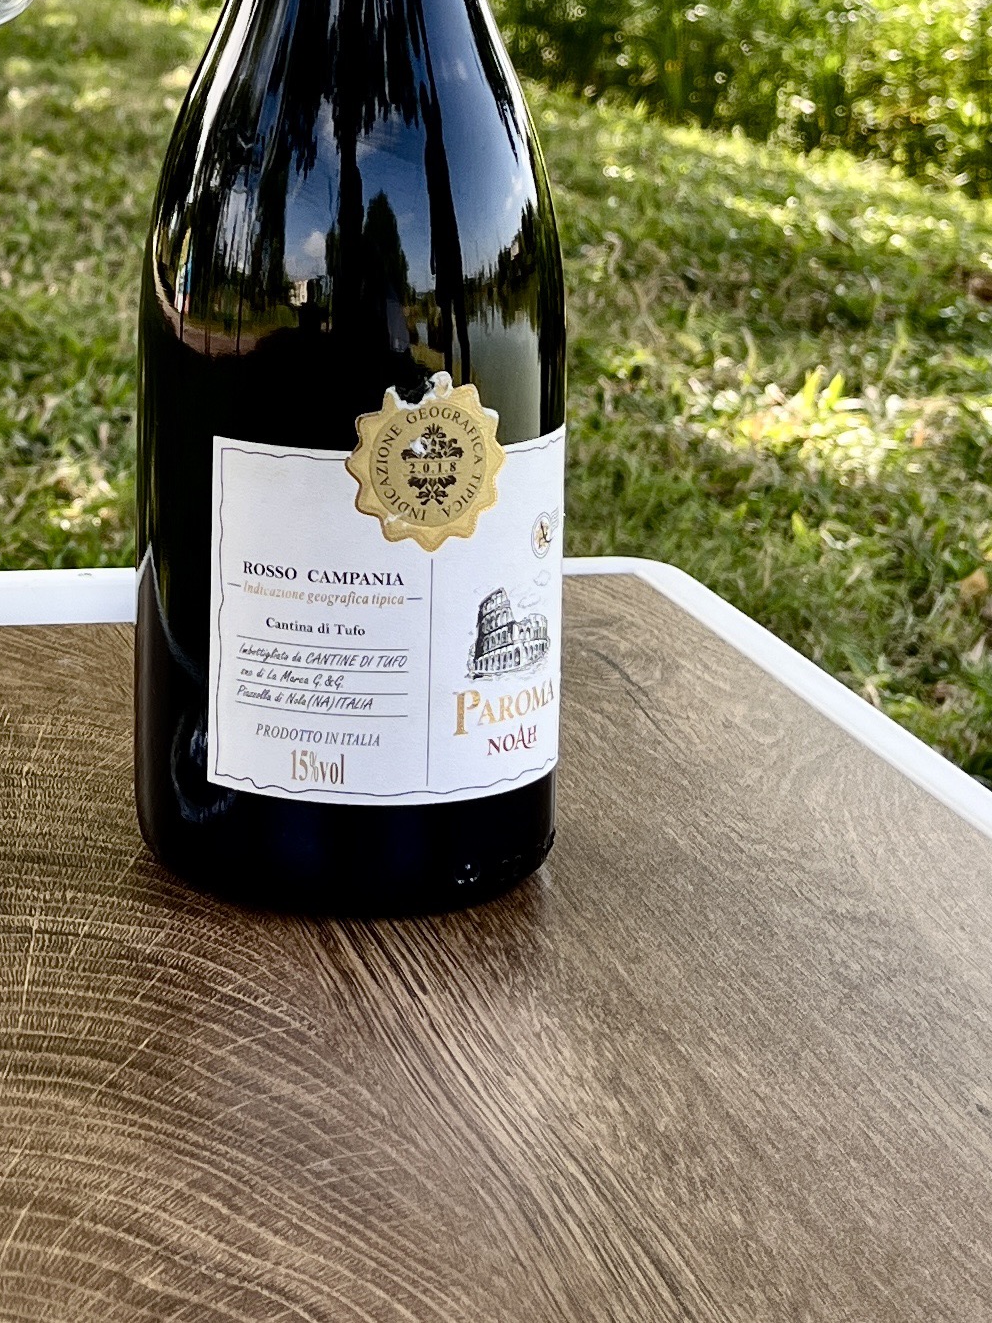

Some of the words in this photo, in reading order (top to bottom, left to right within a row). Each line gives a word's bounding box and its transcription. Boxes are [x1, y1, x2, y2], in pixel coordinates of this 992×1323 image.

[406, 406, 483, 465] GEOGRAFICA
[376, 424, 426, 521] INDICAZIONE
[442, 474, 482, 518] TIPICA
[243, 560, 297, 580] ROSSO
[307, 569, 404, 586] CAMPANIA
[243, 580, 305, 601] Indicazione
[307, 591, 369, 607] geografica
[371, 593, 405, 609] tipica
[266, 616, 313, 634] Cantina
[317, 622, 330, 635] di
[334, 623, 366, 636] Tufo
[305, 652, 359, 668] CANTINE
[359, 655, 375, 668] DI
[376, 655, 408, 668] TUFO
[255, 723, 323, 744] PRODOTTO
[324, 731, 340, 745] IN
[340, 732, 381, 747] ITALIA
[487, 723, 538, 756] NOAH
[290, 749, 345, 785] 15%vol
